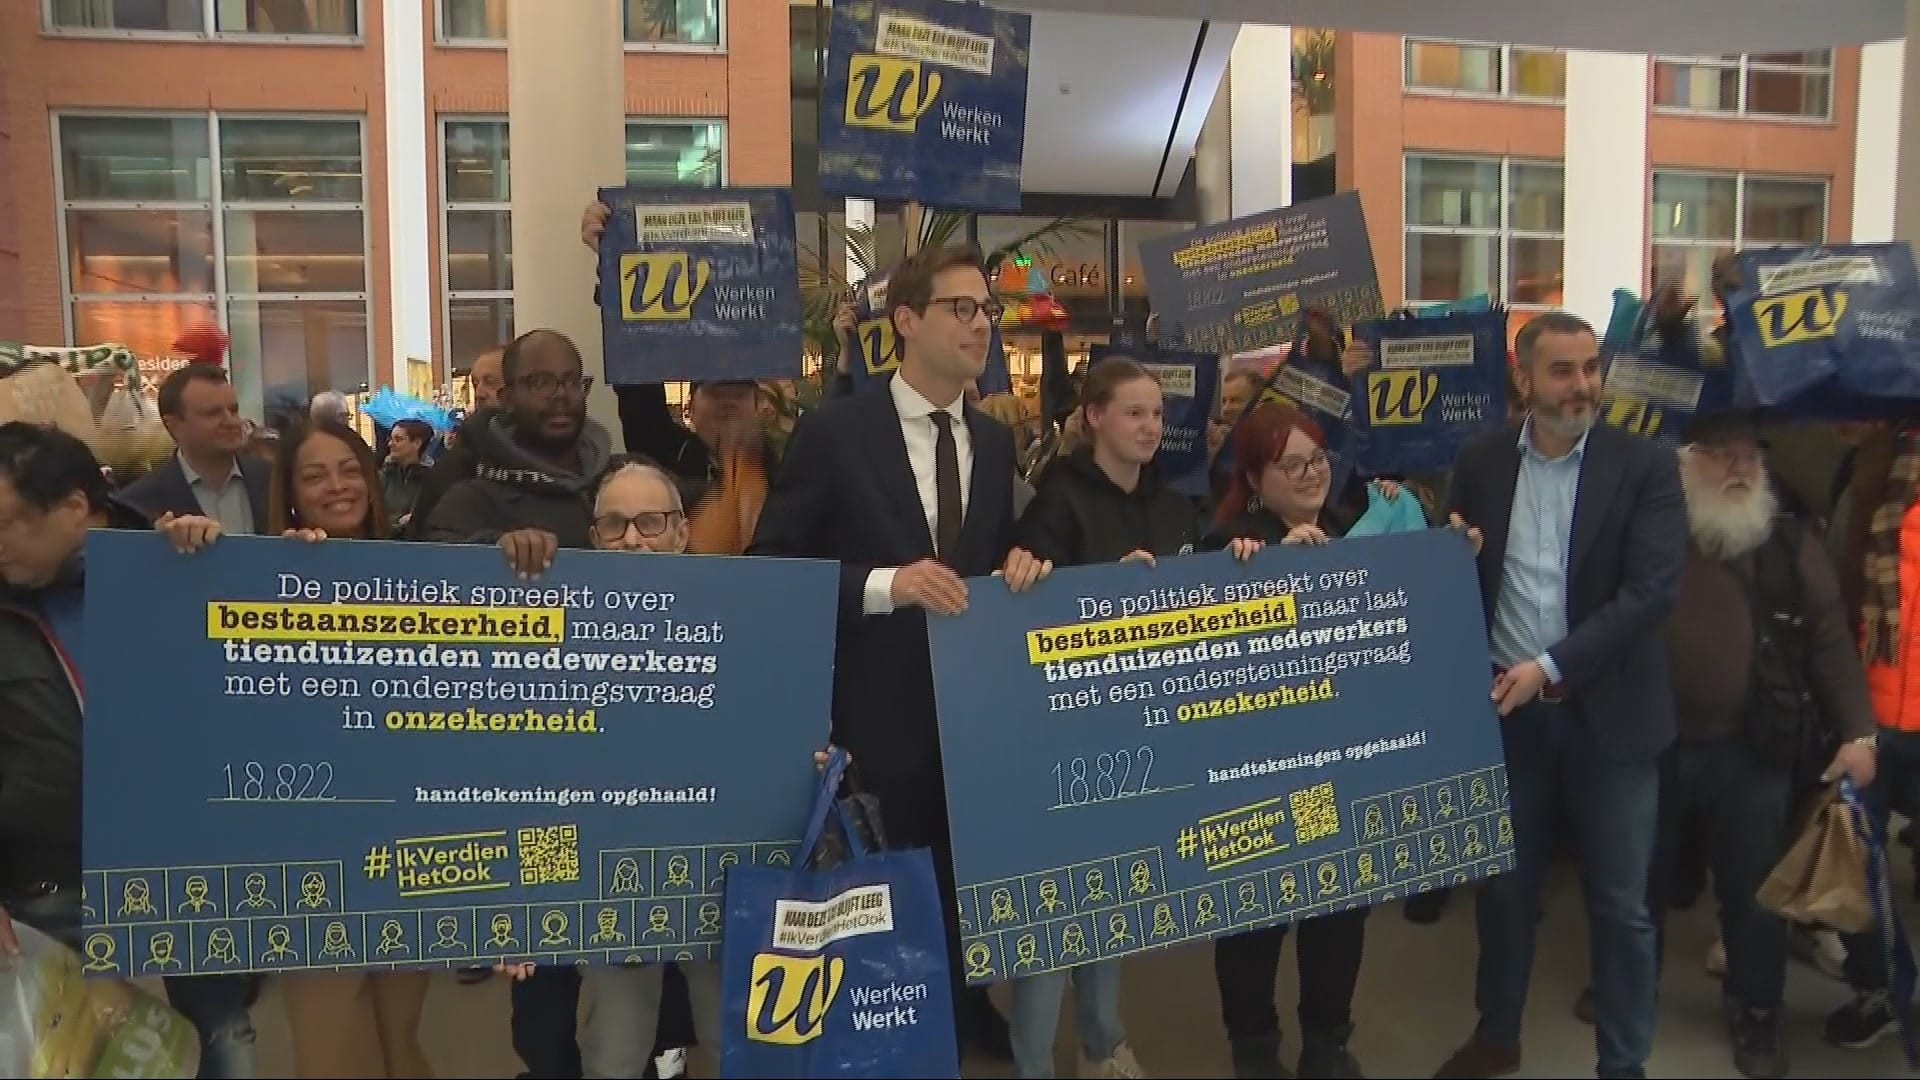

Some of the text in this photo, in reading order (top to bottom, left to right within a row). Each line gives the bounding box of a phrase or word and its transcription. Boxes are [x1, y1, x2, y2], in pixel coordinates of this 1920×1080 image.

[943, 100, 1002, 127] Werken
[941, 121, 991, 146] Werkt
[1050, 264, 1101, 288] Café
[714, 284, 775, 301] Werken
[715, 302, 766, 320] Werkt
[1441, 393, 1490, 407] Werken
[1441, 408, 1483, 421] Werkt
[277, 573, 675, 612] De politiek spreekt over
[1077, 568, 1368, 619] De politiek spreekt over
[218, 605, 724, 643] bestaanszekerheid, maar laat
[1036, 587, 1408, 653] bestaanszekerheid, maar laat
[223, 638, 717, 673] tienduizenden medewerkers
[1044, 617, 1408, 683] tienduizenden medewerkers
[224, 672, 715, 709] met een ondersteuningsvraag
[1048, 640, 1412, 712] met een ondersteuningsvraag
[1143, 678, 1340, 727] in onzekerheid.
[342, 706, 605, 733] in onzekerheid.
[1208, 749, 1342, 783] handtekeningen
[1345, 730, 1426, 760] opgehaald!
[223, 761, 717, 806] 18.822 handtekeningen opgehaald!
[1203, 828, 1275, 865] HetOok
[399, 862, 492, 888] HetOok
[861, 892, 883, 910] LEEG
[850, 981, 927, 1007] Werken
[852, 1006, 918, 1031] Werkt
